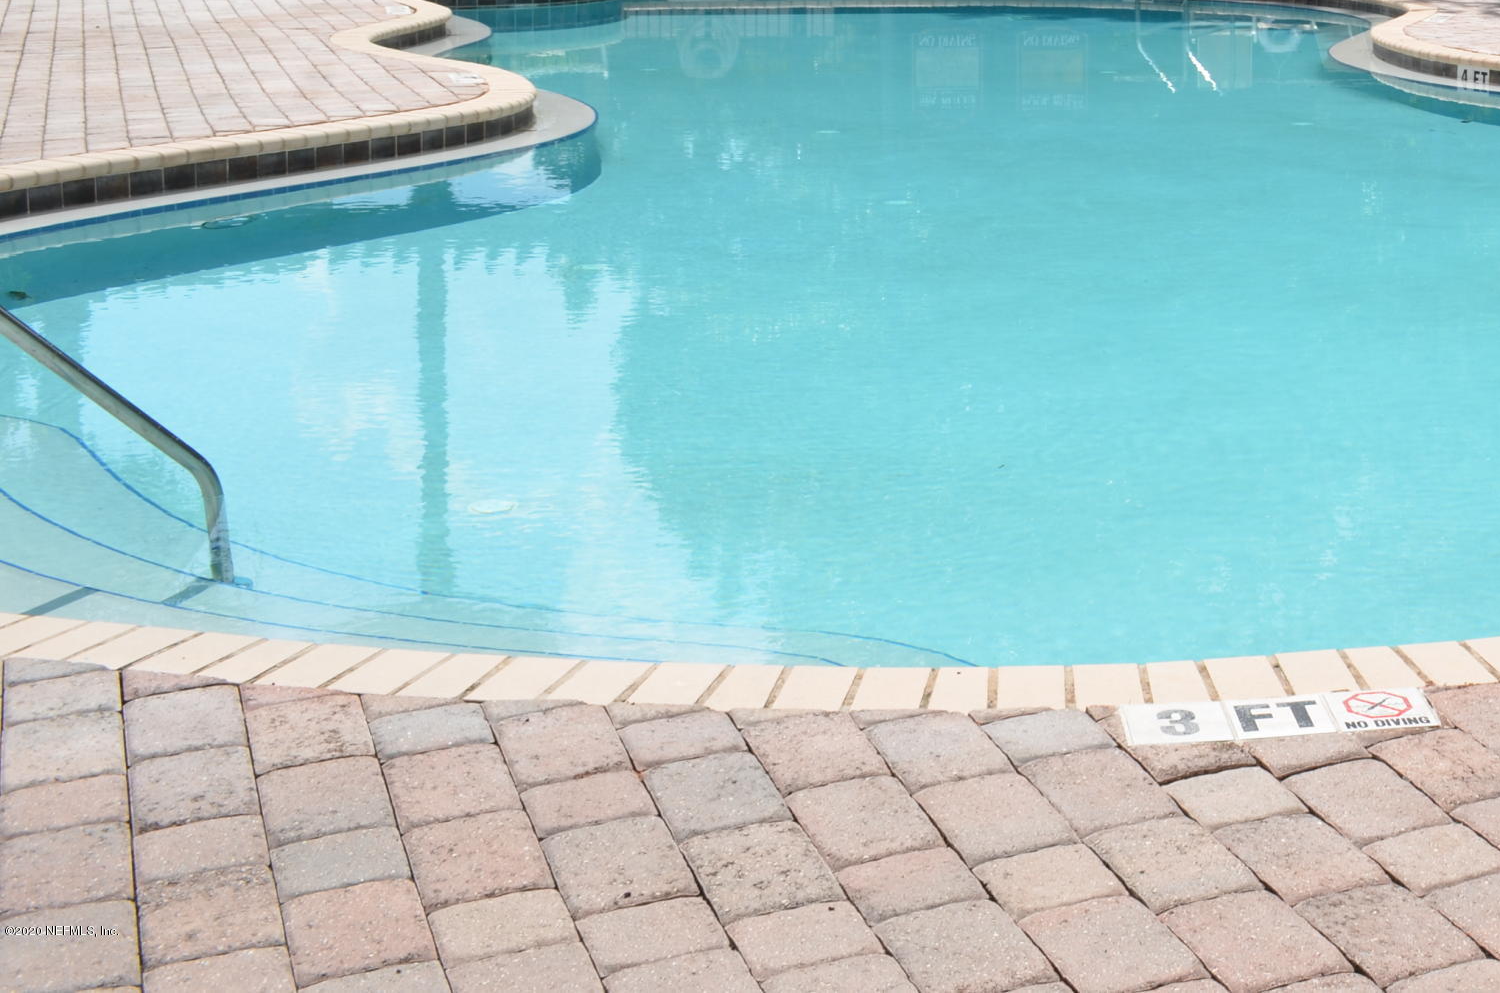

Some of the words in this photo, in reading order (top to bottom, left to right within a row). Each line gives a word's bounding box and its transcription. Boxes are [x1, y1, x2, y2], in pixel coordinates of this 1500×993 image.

[1461, 69, 1468, 81] 4
[1473, 70, 1488, 84] FT
[1156, 708, 1201, 736] 3
[1233, 699, 1318, 733] FT
[1345, 717, 1370, 730] NO
[1374, 715, 1431, 728] DIVING
